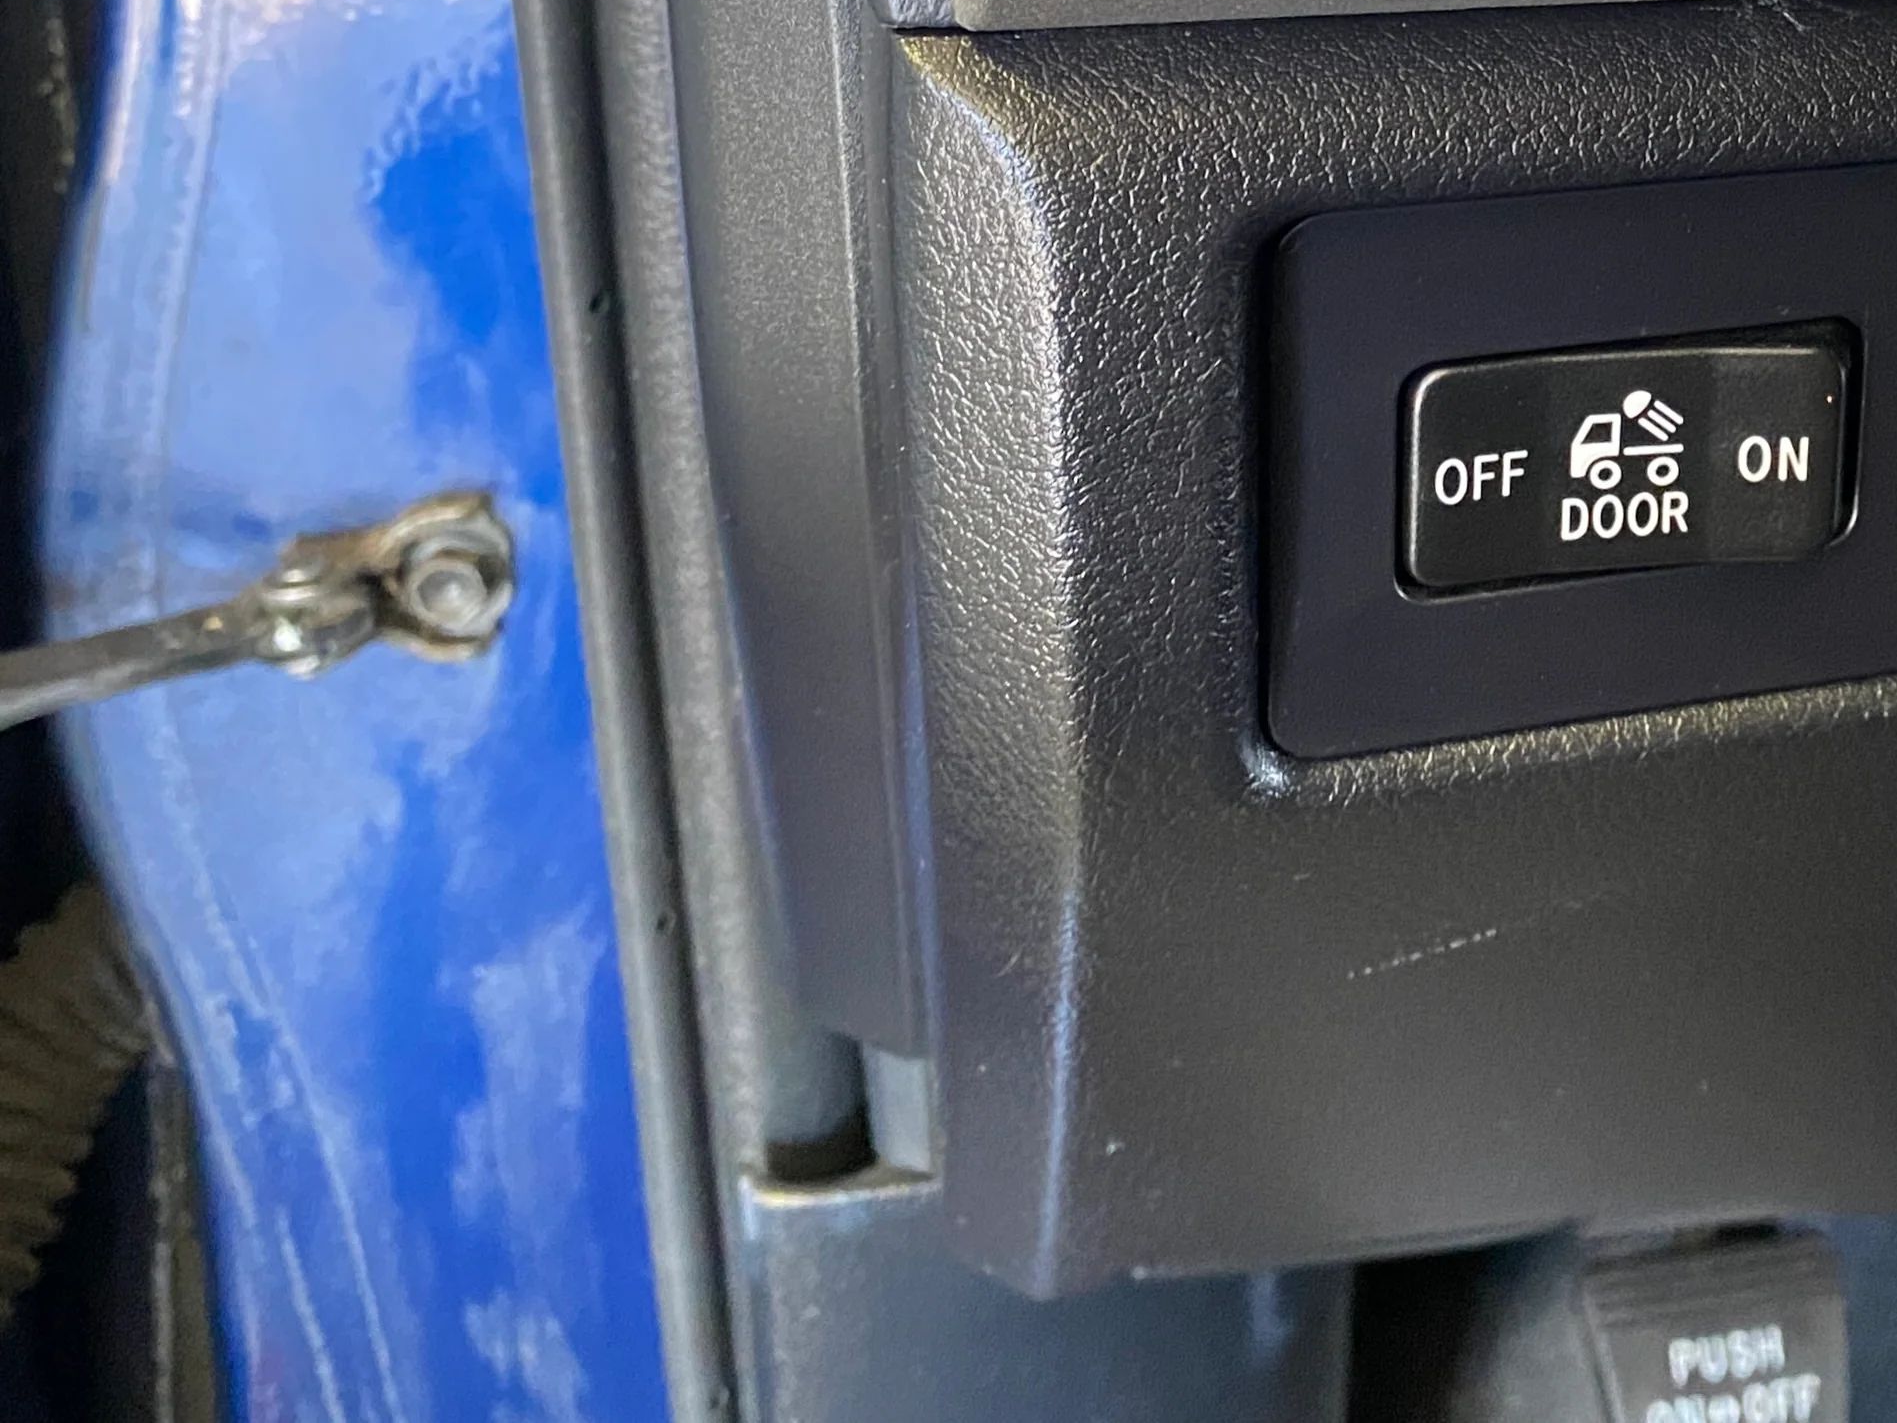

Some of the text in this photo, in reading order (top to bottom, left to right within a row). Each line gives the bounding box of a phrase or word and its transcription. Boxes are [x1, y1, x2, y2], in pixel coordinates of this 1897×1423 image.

[1434, 449, 1529, 507] OFF
[1737, 434, 1810, 484] ON
[1559, 490, 1689, 542] DOOR
[1667, 1323, 1785, 1389] PUSH
